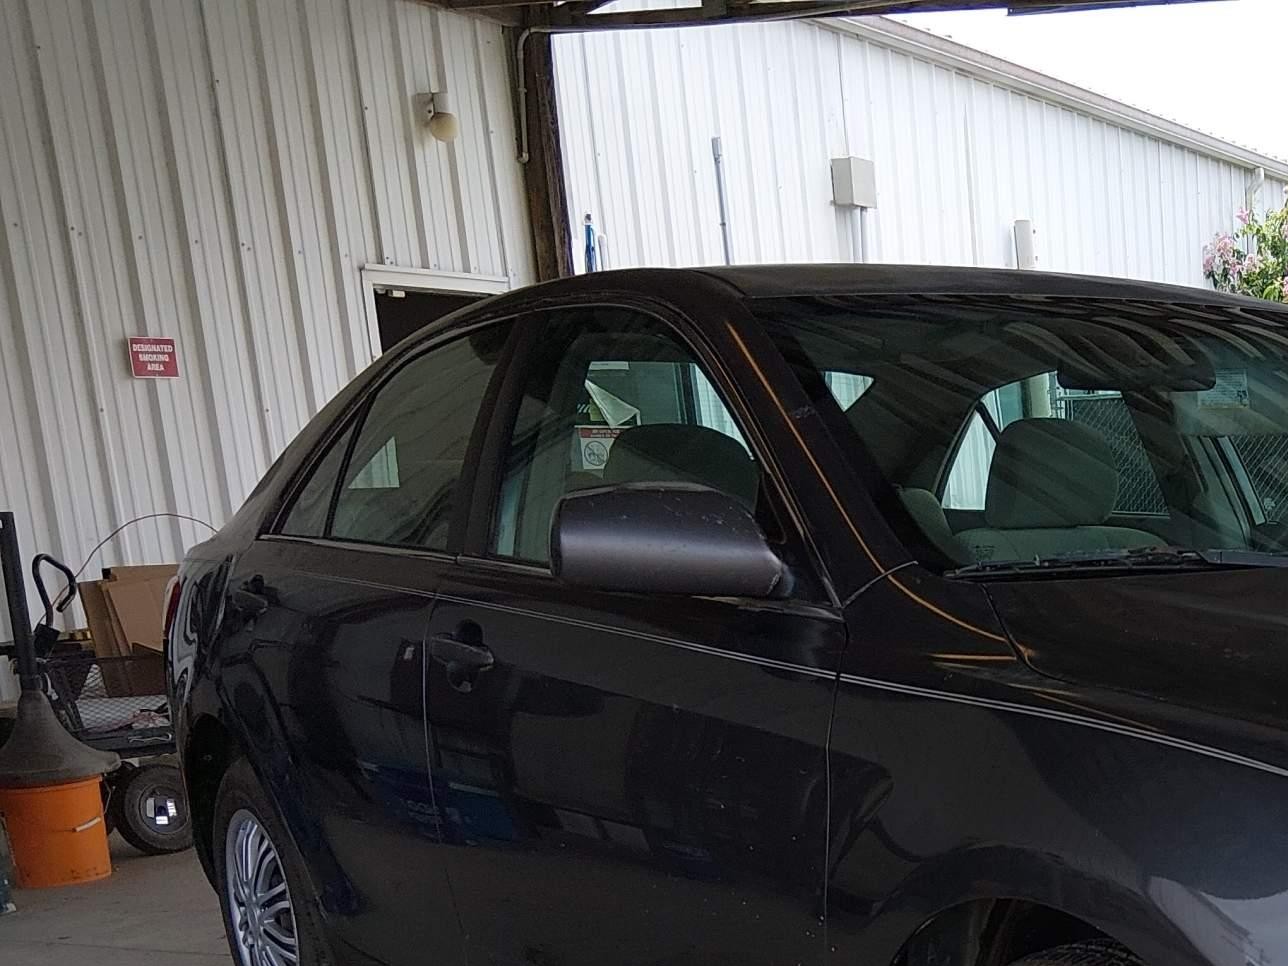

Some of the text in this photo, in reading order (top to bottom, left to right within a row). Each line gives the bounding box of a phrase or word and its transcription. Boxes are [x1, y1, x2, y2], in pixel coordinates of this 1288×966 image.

[132, 343, 173, 352] DESIGNATED
[138, 353, 169, 362] SMOKING
[147, 362, 165, 371] AREA
